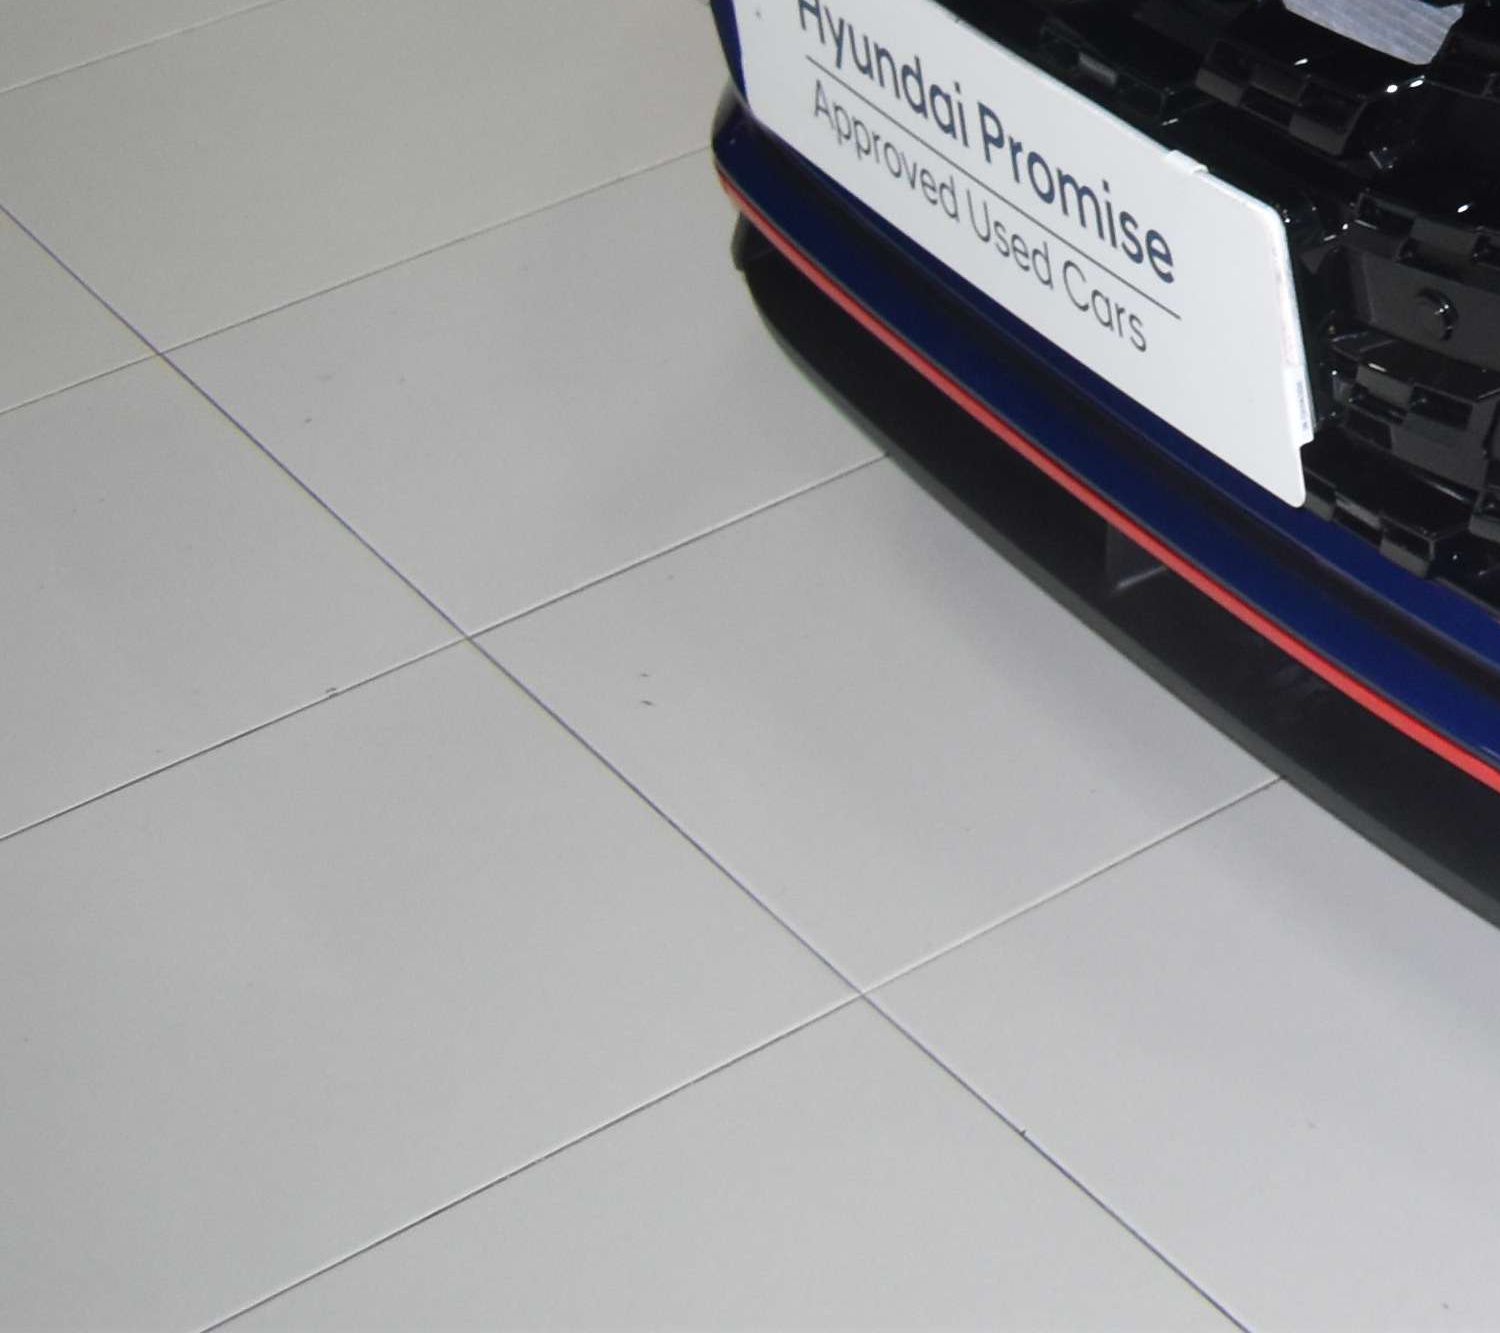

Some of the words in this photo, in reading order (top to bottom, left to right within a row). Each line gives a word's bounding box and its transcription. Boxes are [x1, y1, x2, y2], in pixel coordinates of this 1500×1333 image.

[813, 79, 960, 223] Approved
[966, 188, 1054, 289] Used
[1062, 260, 1147, 352] Cars
[977, 100, 1174, 284] Promise
